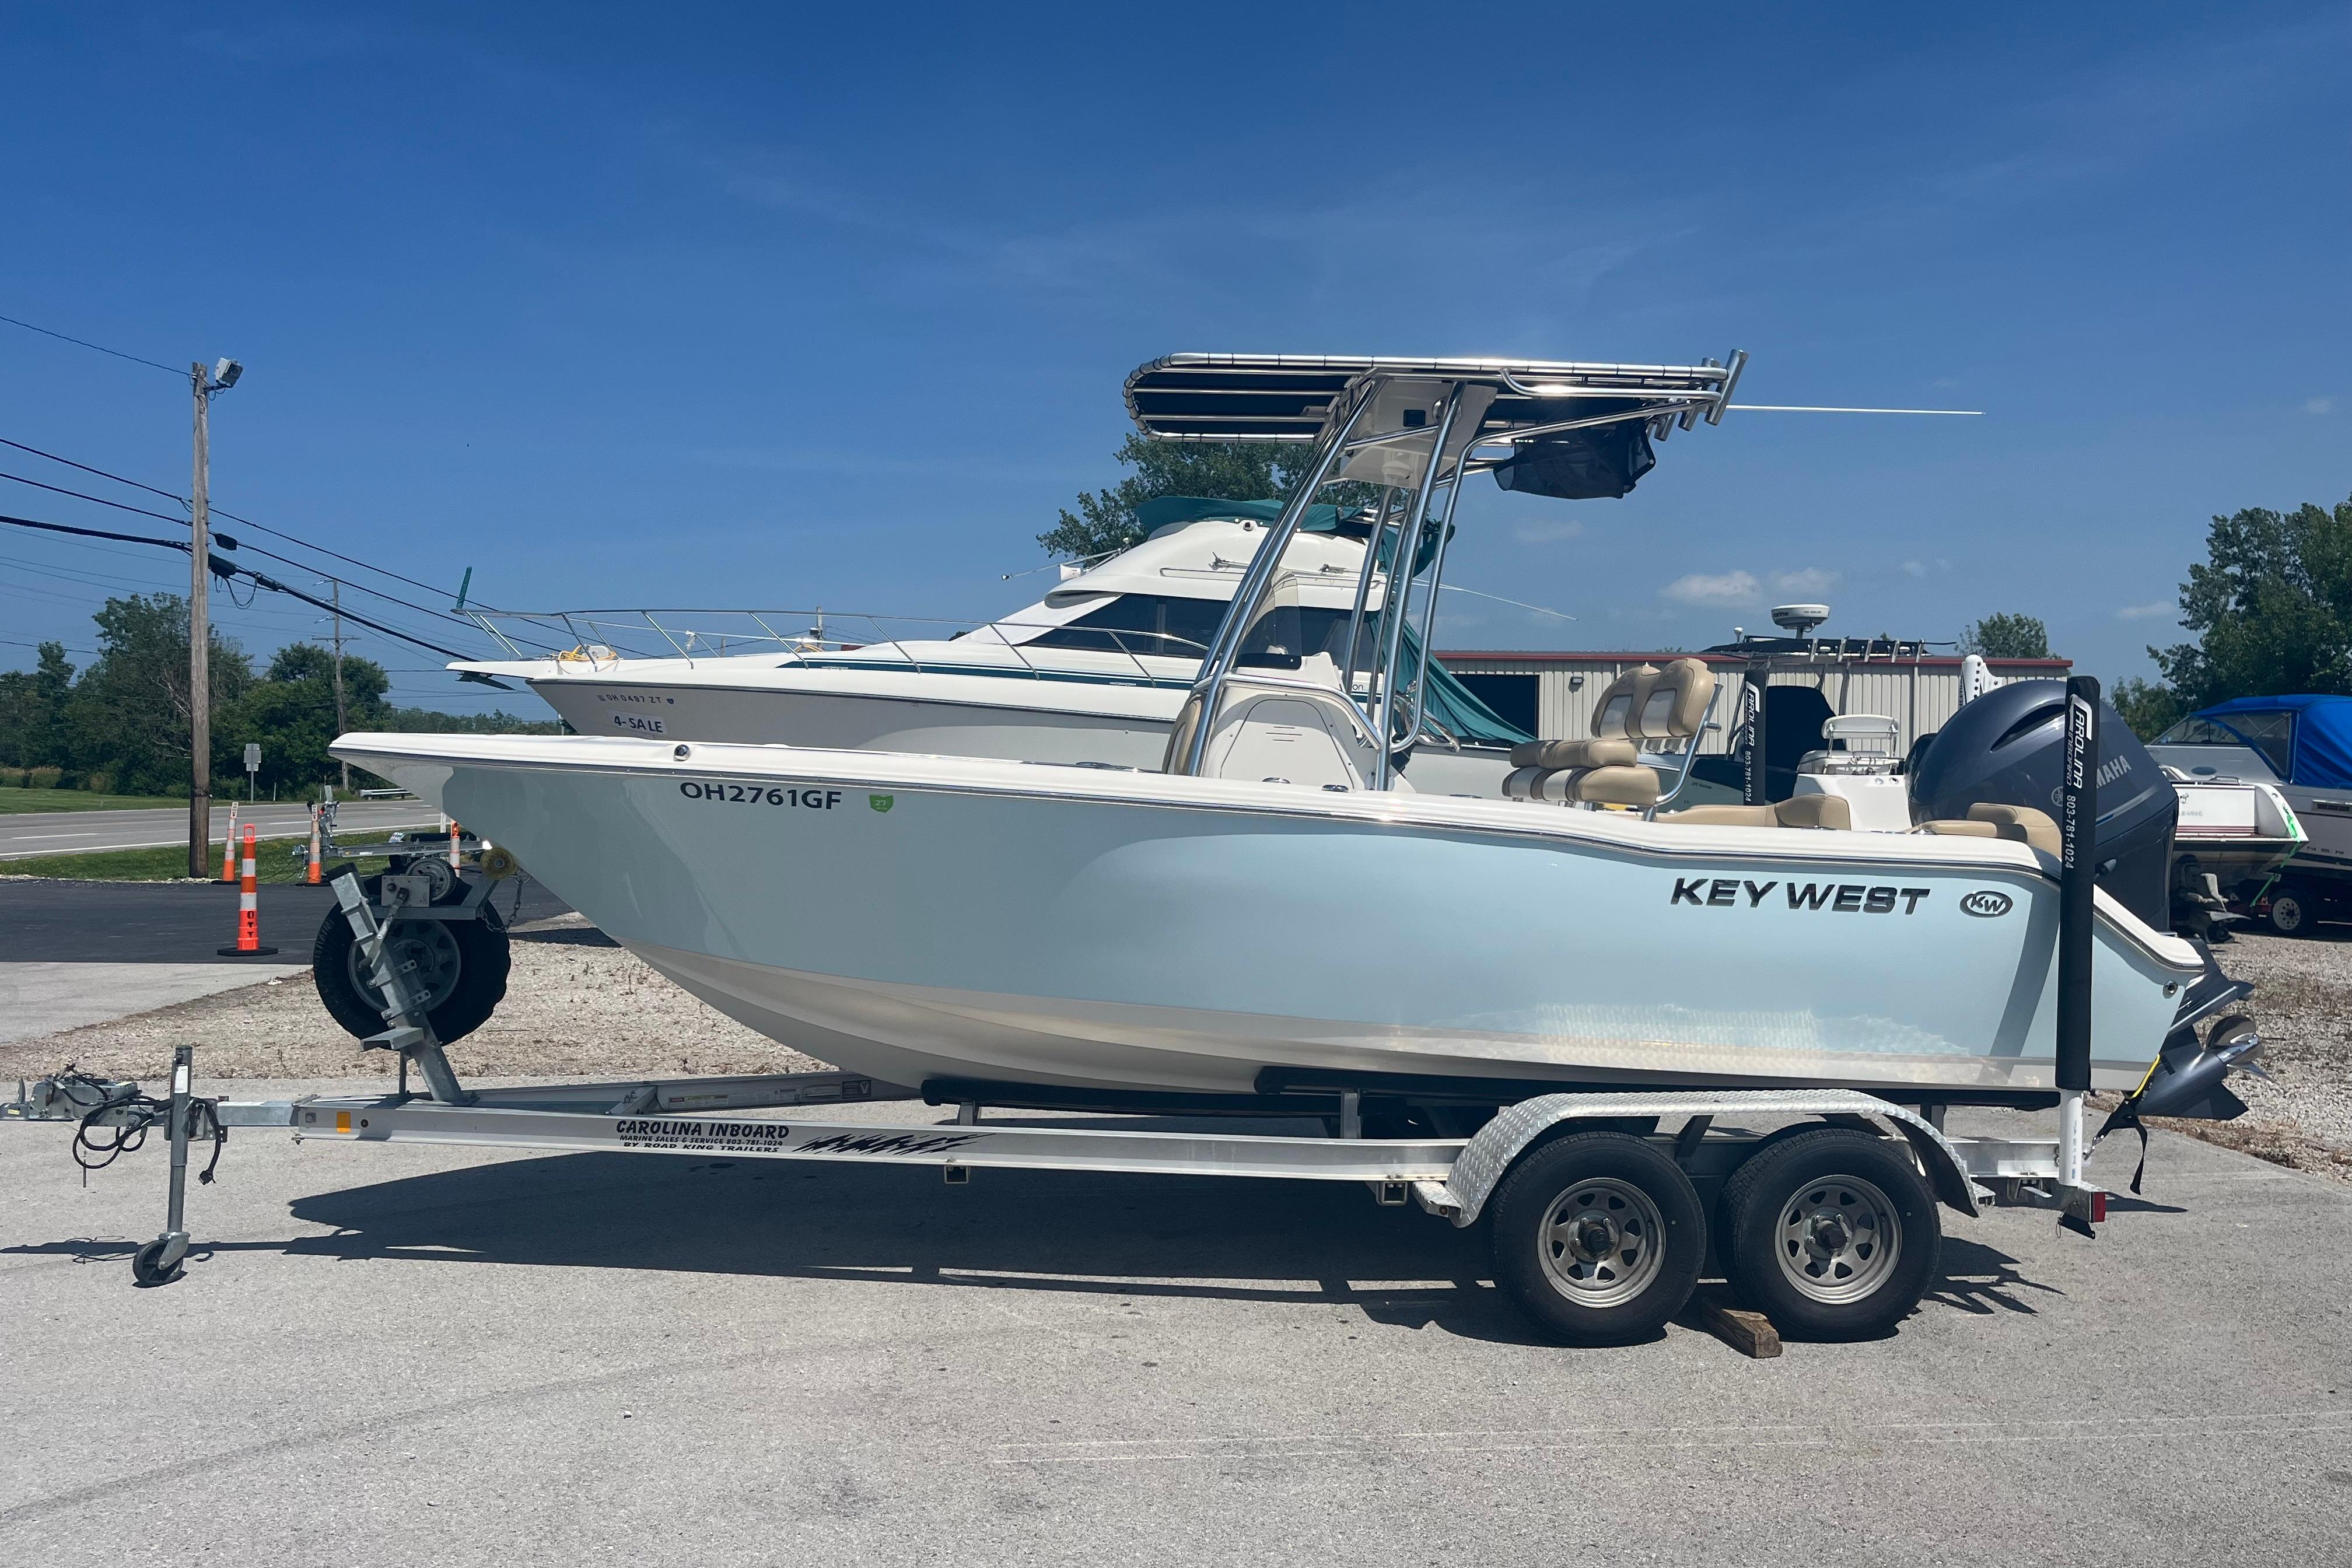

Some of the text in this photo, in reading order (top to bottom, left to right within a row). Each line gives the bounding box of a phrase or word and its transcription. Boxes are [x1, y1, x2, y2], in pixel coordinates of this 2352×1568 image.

[1745, 681, 1760, 747] CAROLINA
[2069, 694, 2092, 789] CAROLINA
[2096, 755, 2132, 789] MAHA
[680, 782, 842, 809] OH2761GF
[2065, 794, 2076, 869] 803-781-1024
[1671, 878, 1931, 915] KEY WEST
[1971, 895, 2005, 912] KW
[617, 1120, 789, 1139] CAROLINA INBOARD
